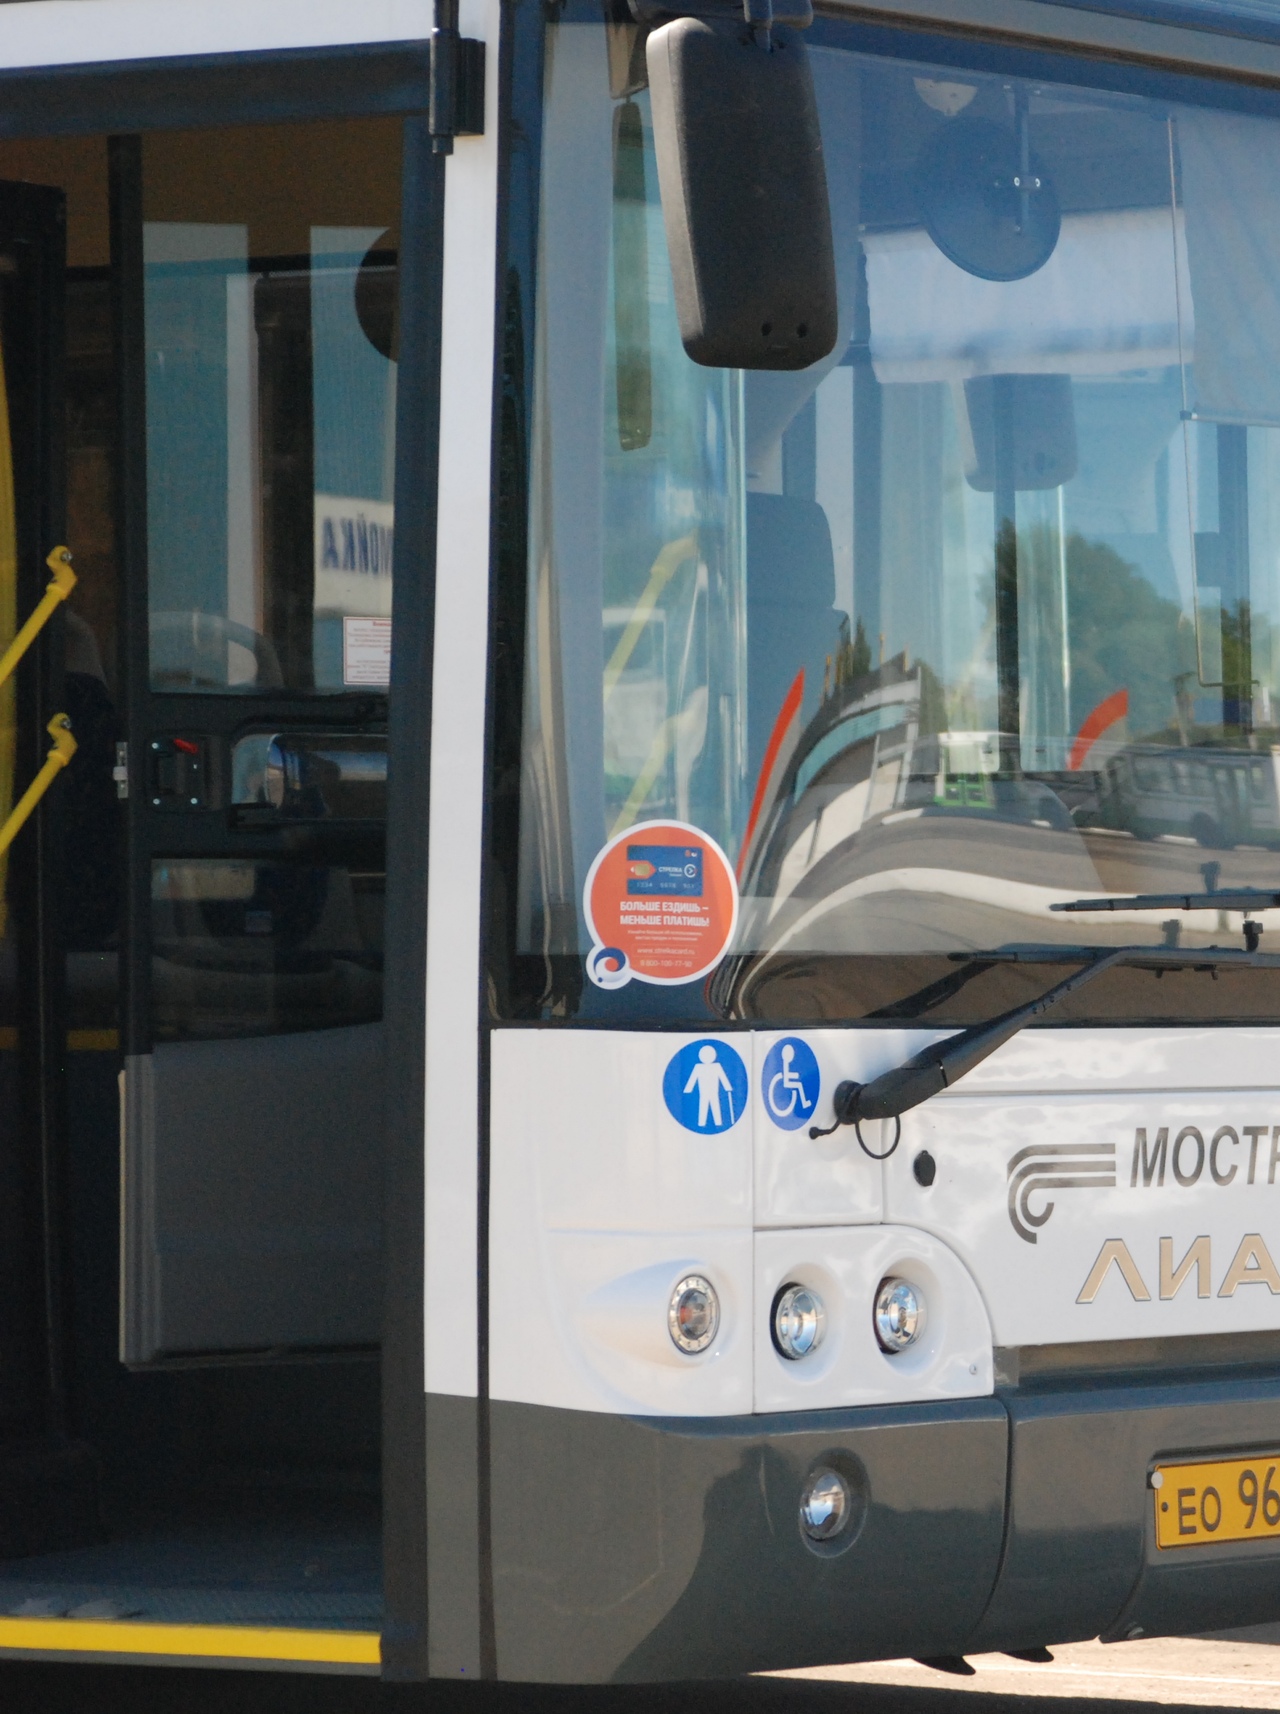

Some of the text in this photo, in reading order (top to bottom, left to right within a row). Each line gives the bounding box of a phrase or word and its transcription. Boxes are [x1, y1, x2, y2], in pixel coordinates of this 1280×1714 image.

[619, 901, 661, 911] БОЛЬШЕ
[662, 901, 701, 913] ЕЗДИШЬ
[619, 915, 710, 927] МЕНЬШЕ ПЛАТИШЬ!
